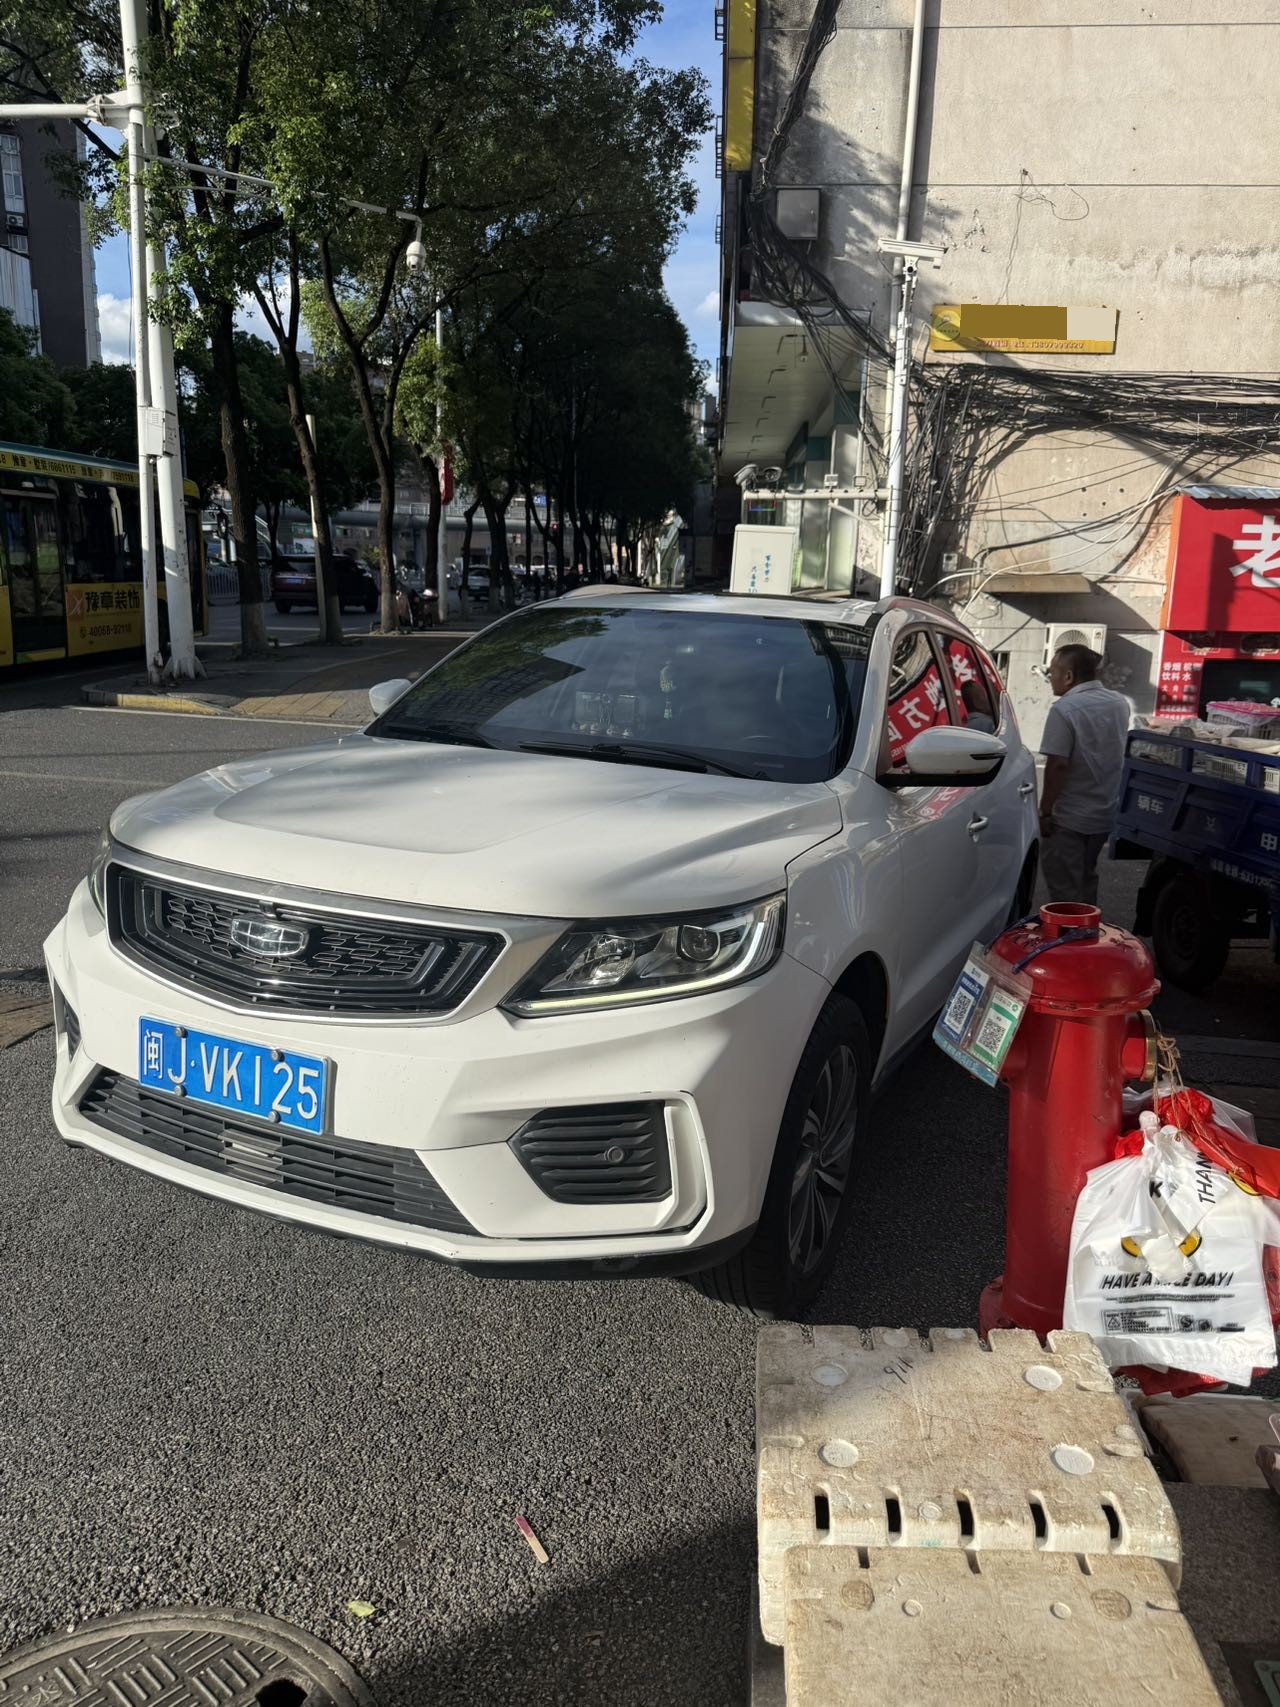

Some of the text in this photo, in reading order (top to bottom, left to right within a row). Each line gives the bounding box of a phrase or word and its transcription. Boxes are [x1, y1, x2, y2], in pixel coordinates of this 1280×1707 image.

[1229, 515, 1280, 588] 老
[85, 590, 141, 613] 豫章装饰
[1162, 672, 1192, 682] 饮料 水
[1195, 1152, 1217, 1204] THAN
[1101, 1272, 1141, 1290] HAVE
[1142, 1271, 1153, 1287] A
[1194, 1271, 1235, 1287] DAY!
